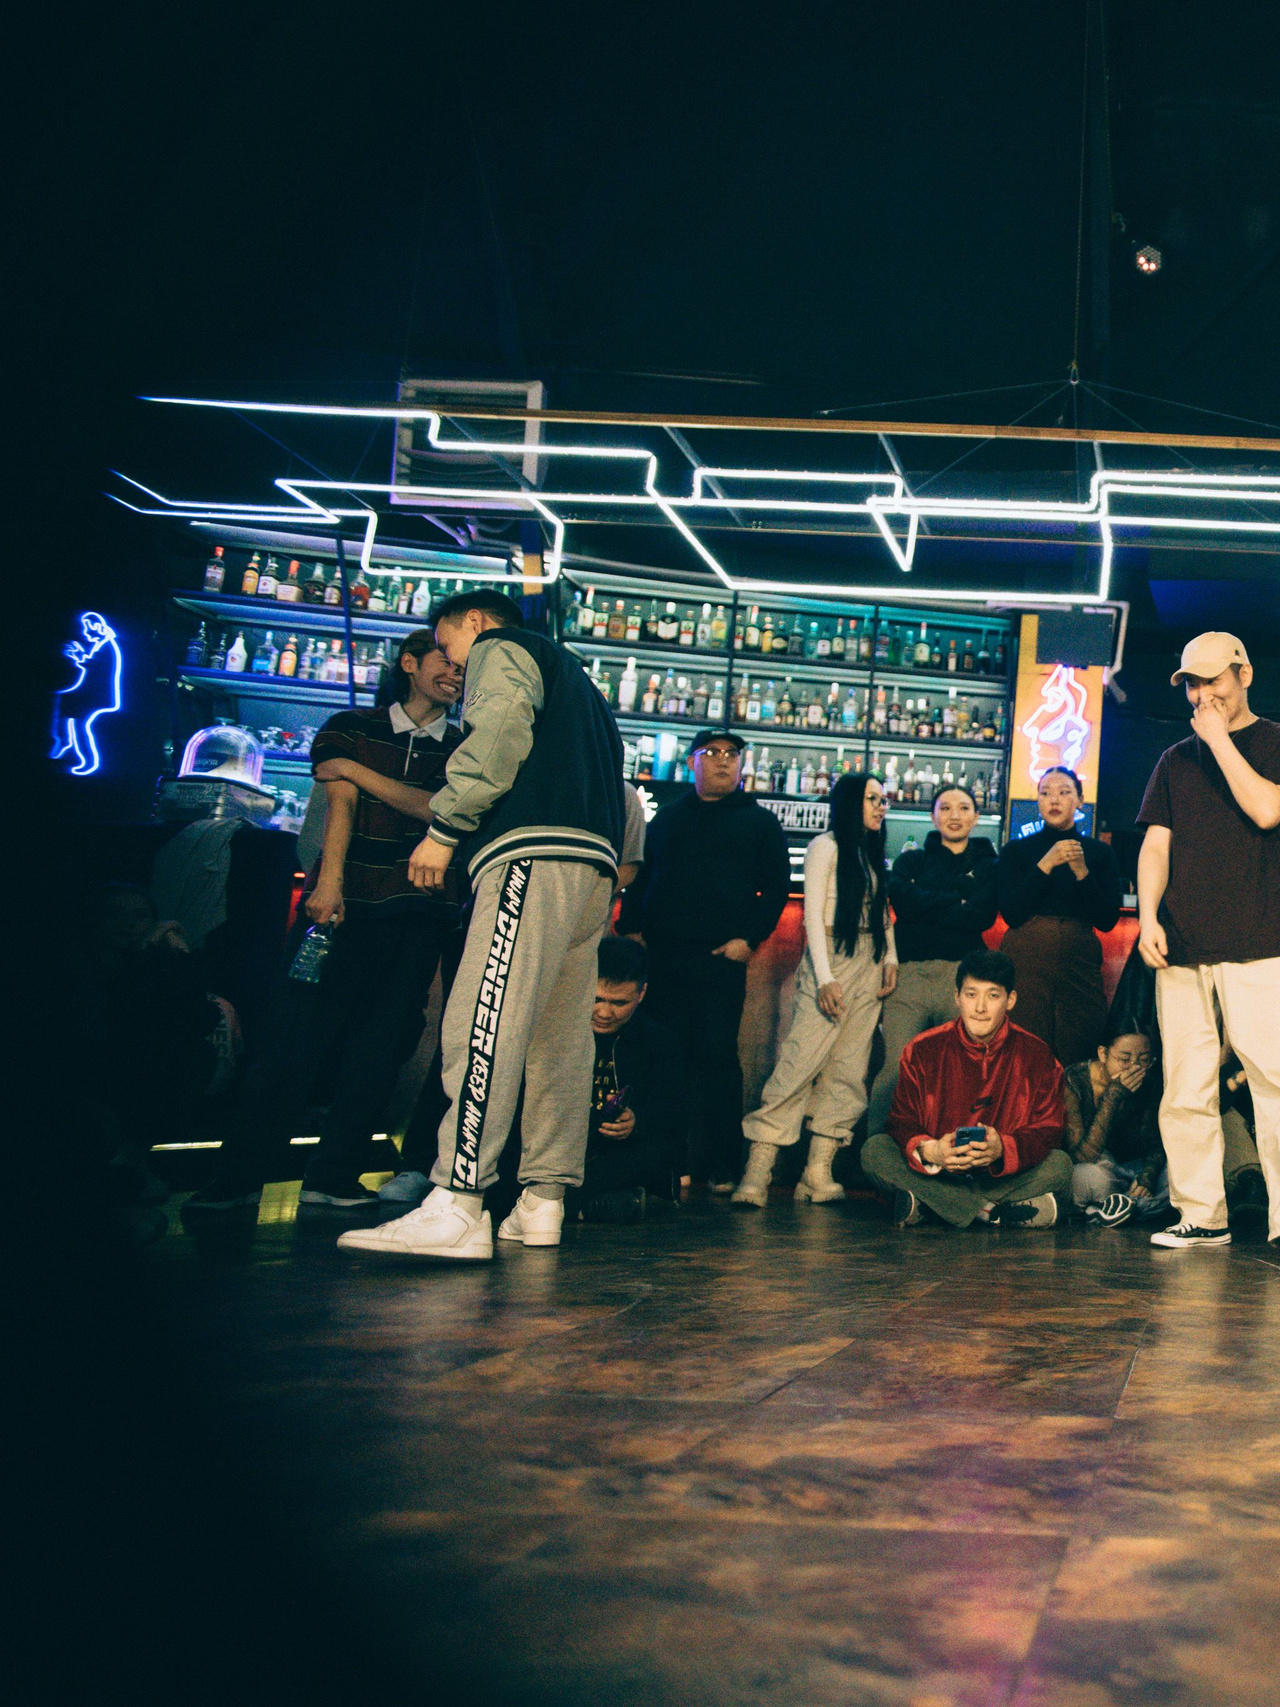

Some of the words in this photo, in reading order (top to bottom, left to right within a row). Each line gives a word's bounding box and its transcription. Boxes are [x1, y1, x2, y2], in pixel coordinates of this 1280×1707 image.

[471, 909, 520, 1057] DANGER
[467, 1052, 490, 1103] KEEP
[460, 1100, 483, 1158] AWAY
